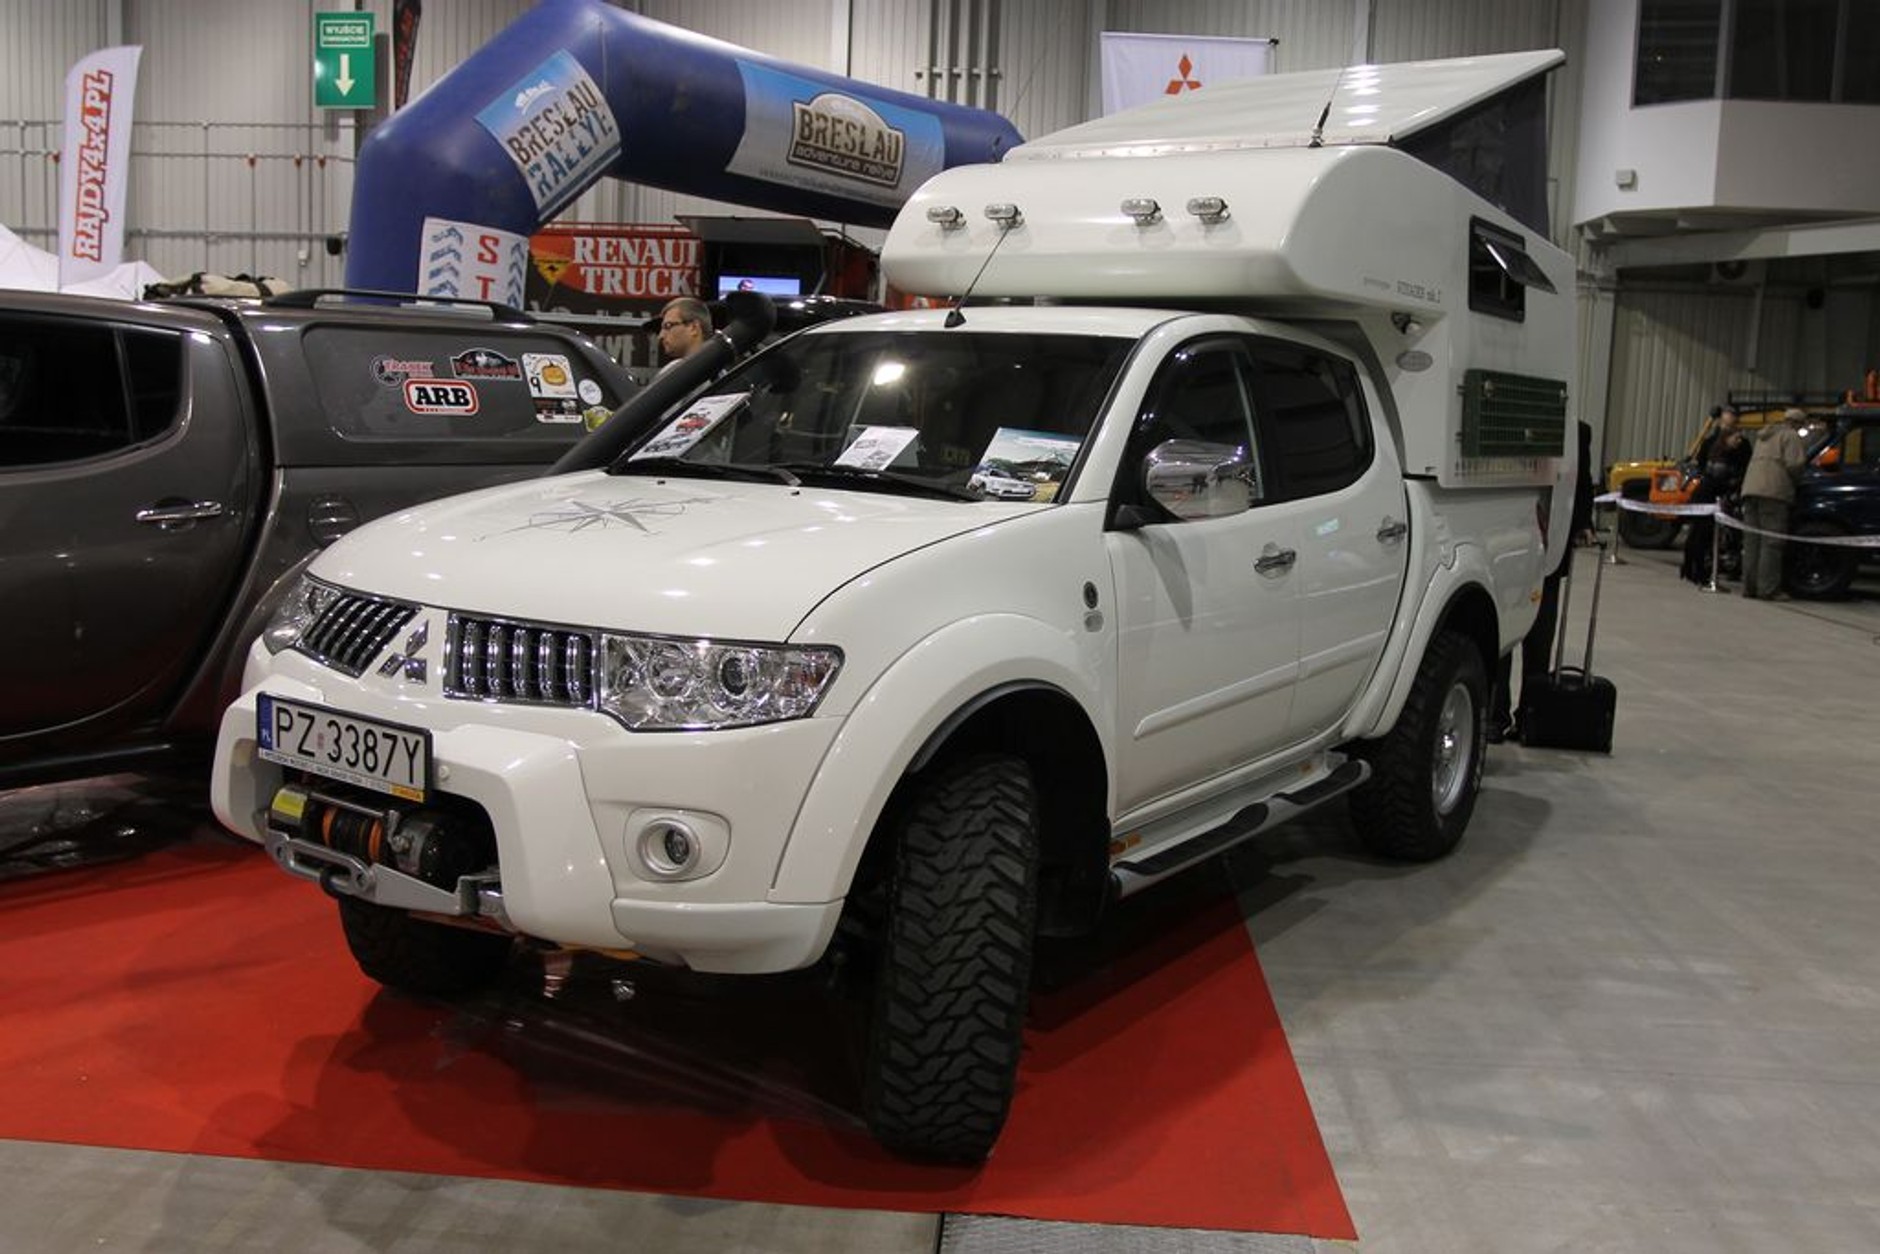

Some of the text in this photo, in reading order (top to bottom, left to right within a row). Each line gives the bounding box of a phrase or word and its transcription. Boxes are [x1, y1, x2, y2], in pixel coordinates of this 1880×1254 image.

[506, 80, 599, 165] BRESLAU
[799, 109, 901, 164] BRESLAU
[415, 386, 471, 406] ARB
[275, 706, 316, 758] PZ
[326, 719, 421, 785] 3387Y
